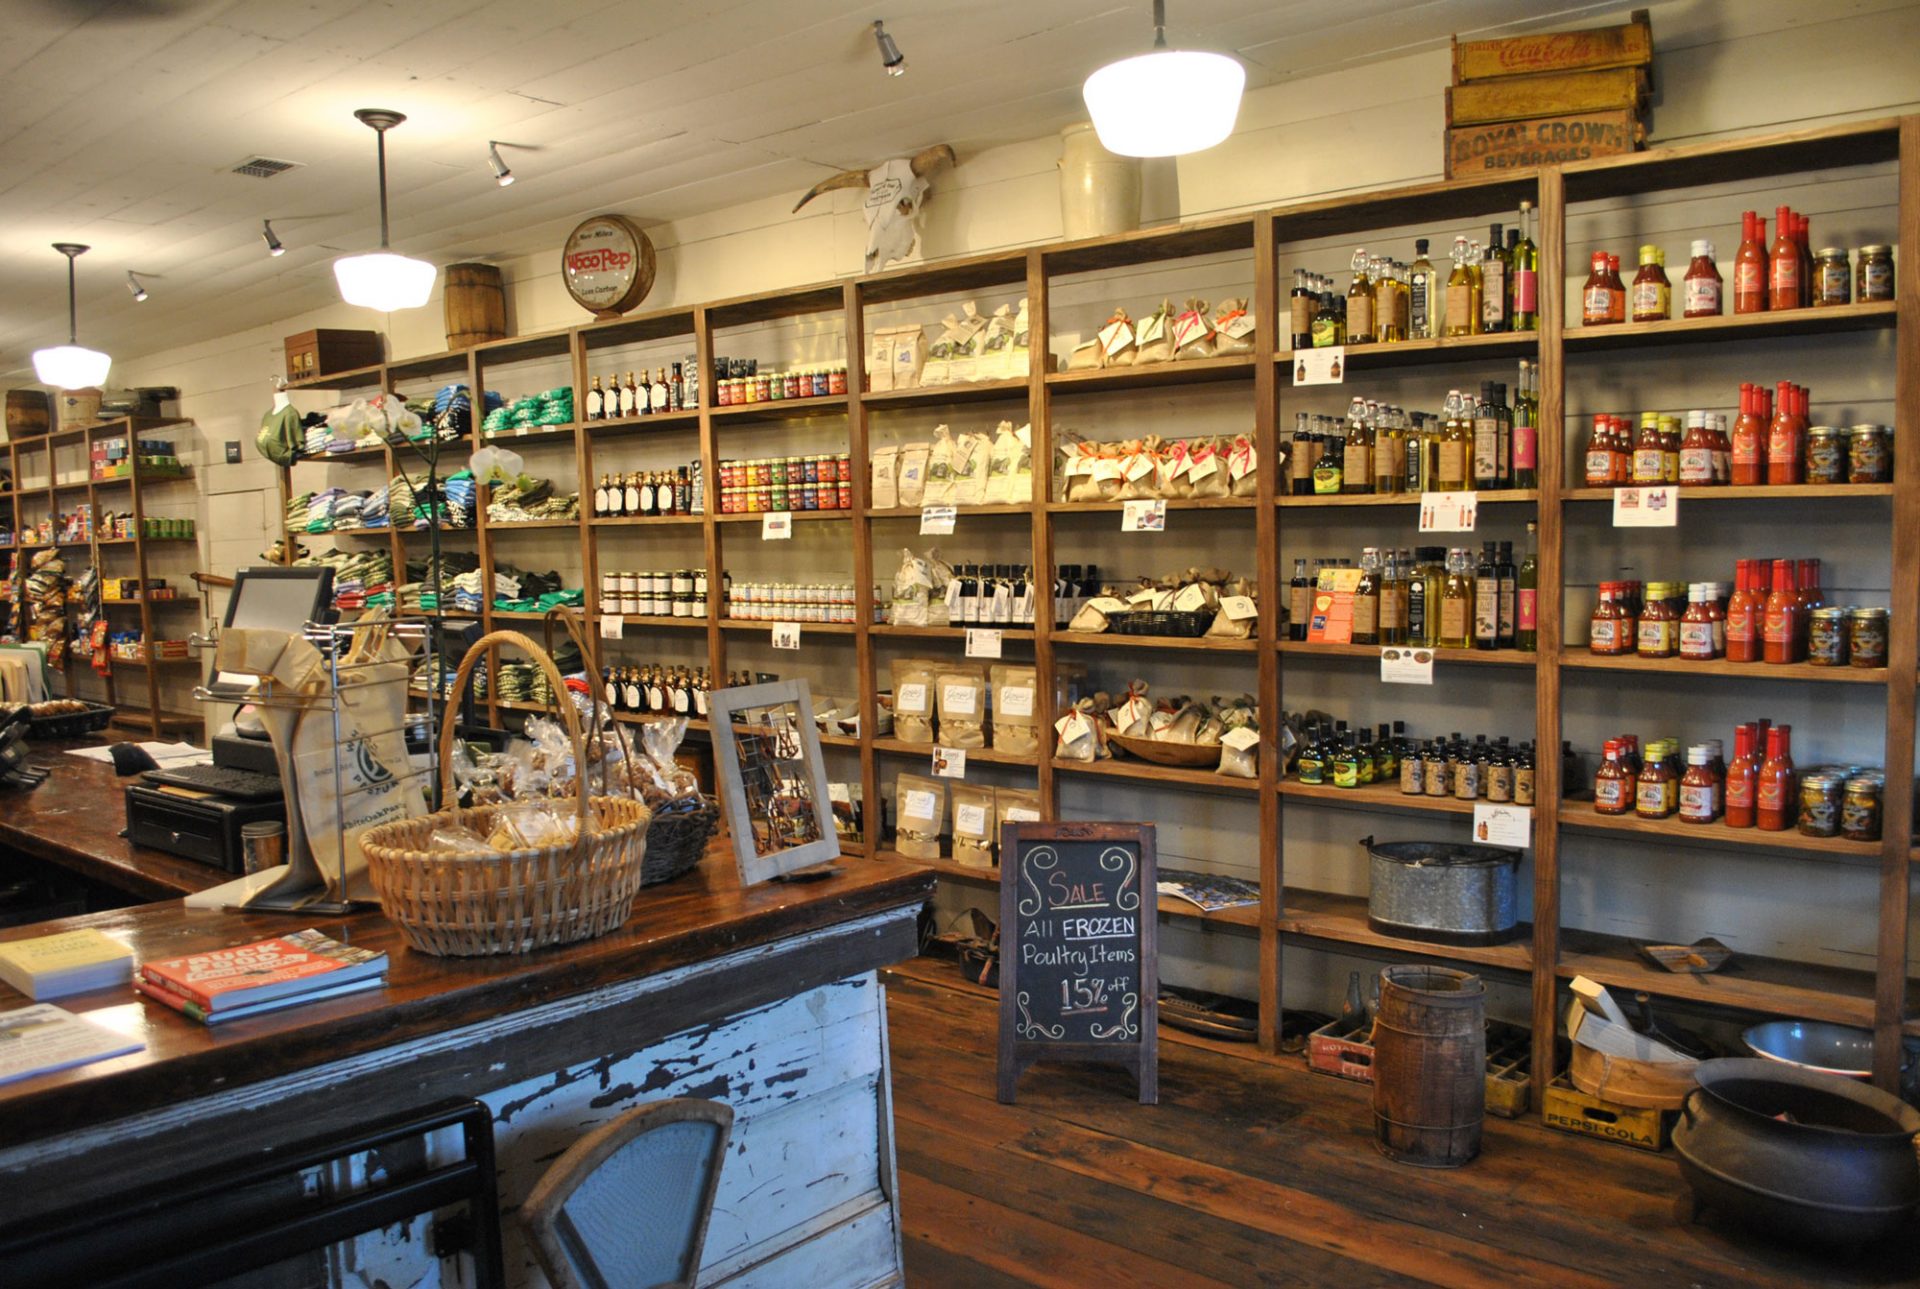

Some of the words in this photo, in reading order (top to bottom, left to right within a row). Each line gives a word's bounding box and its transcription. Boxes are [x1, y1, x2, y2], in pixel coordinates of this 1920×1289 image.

[1456, 126, 1532, 162] ROYAL
[1537, 123, 1622, 147] CROWN
[1485, 147, 1591, 168] BEVERAGES
[1024, 919, 1053, 938] All
[1063, 916, 1135, 936] FROZEN
[161, 942, 282, 968] TRUCK
[188, 953, 281, 973] FOOD
[1023, 943, 1089, 976] Poultry
[1091, 945, 1135, 964] Items
[1061, 978, 1108, 1010] 15%
[1108, 976, 1130, 993] off
[1547, 1112, 1654, 1146] PEPSI-COLA
